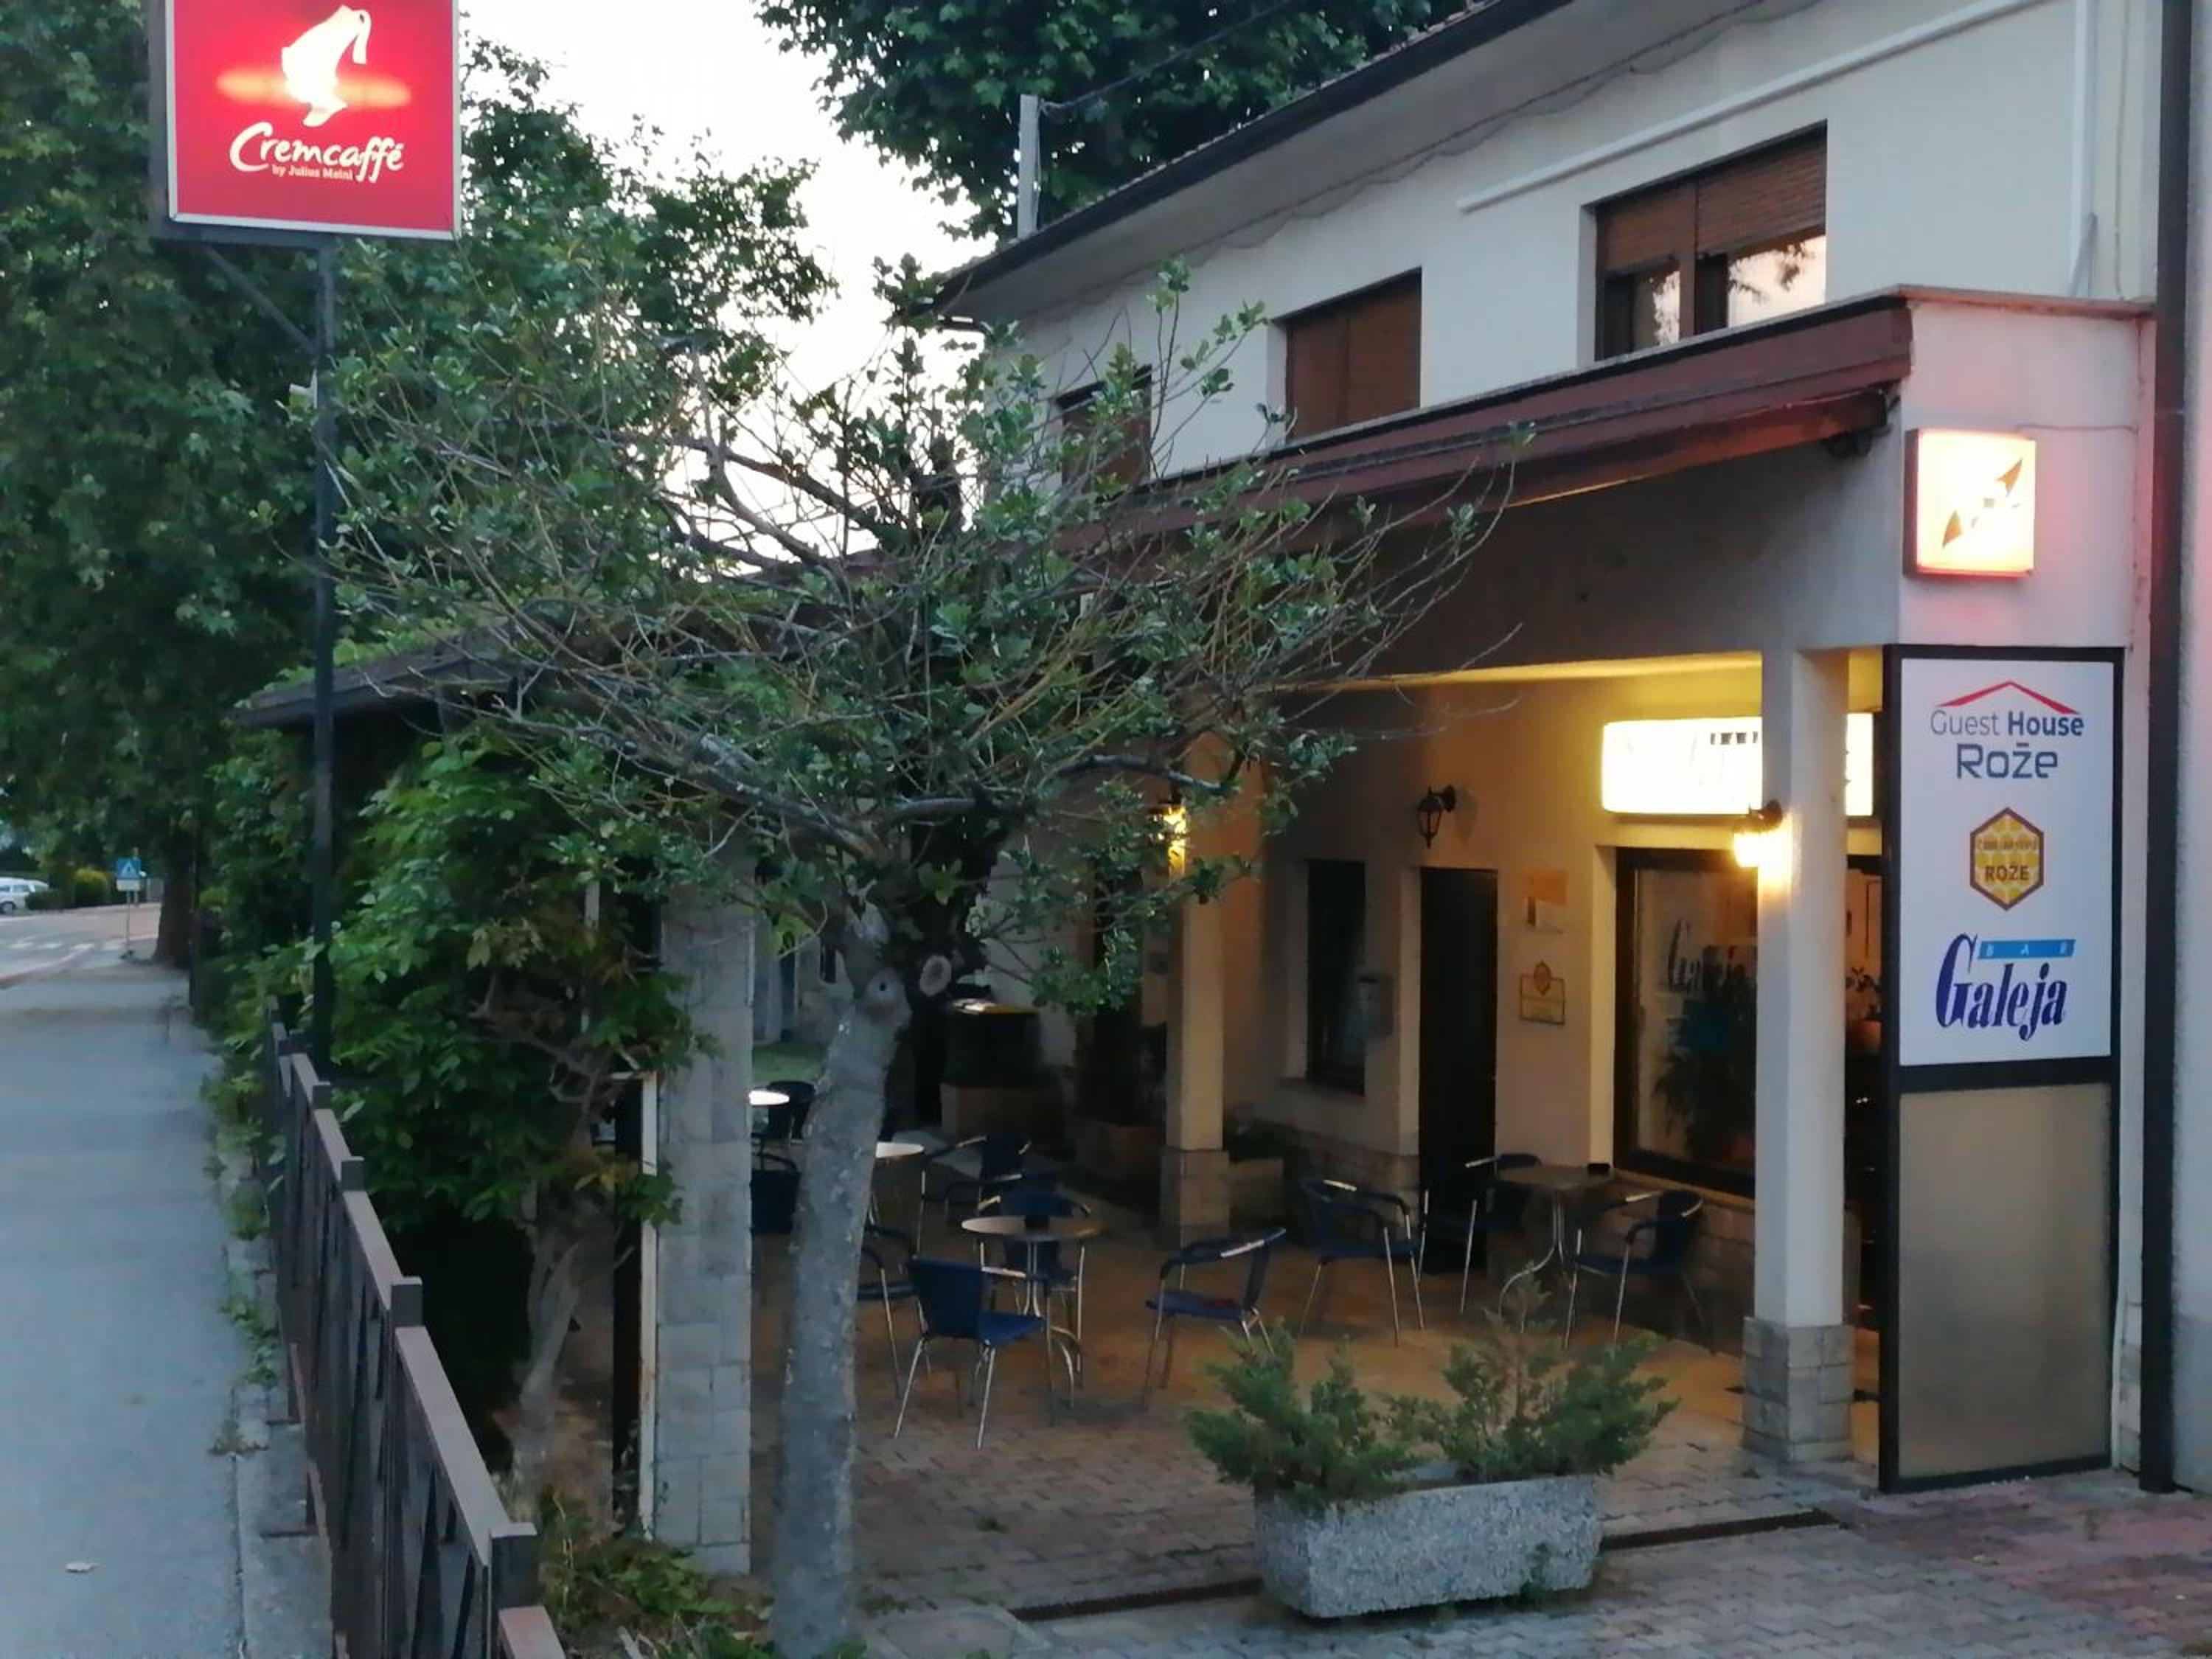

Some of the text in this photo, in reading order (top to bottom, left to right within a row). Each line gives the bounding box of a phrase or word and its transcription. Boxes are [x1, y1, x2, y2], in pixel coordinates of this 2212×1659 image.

[272, 164, 286, 177] by
[289, 167, 321, 178] Julius
[1930, 709, 2085, 736] Guest House
[1956, 742, 2058, 779] Rože
[1935, 933, 2067, 1042] Galeja
